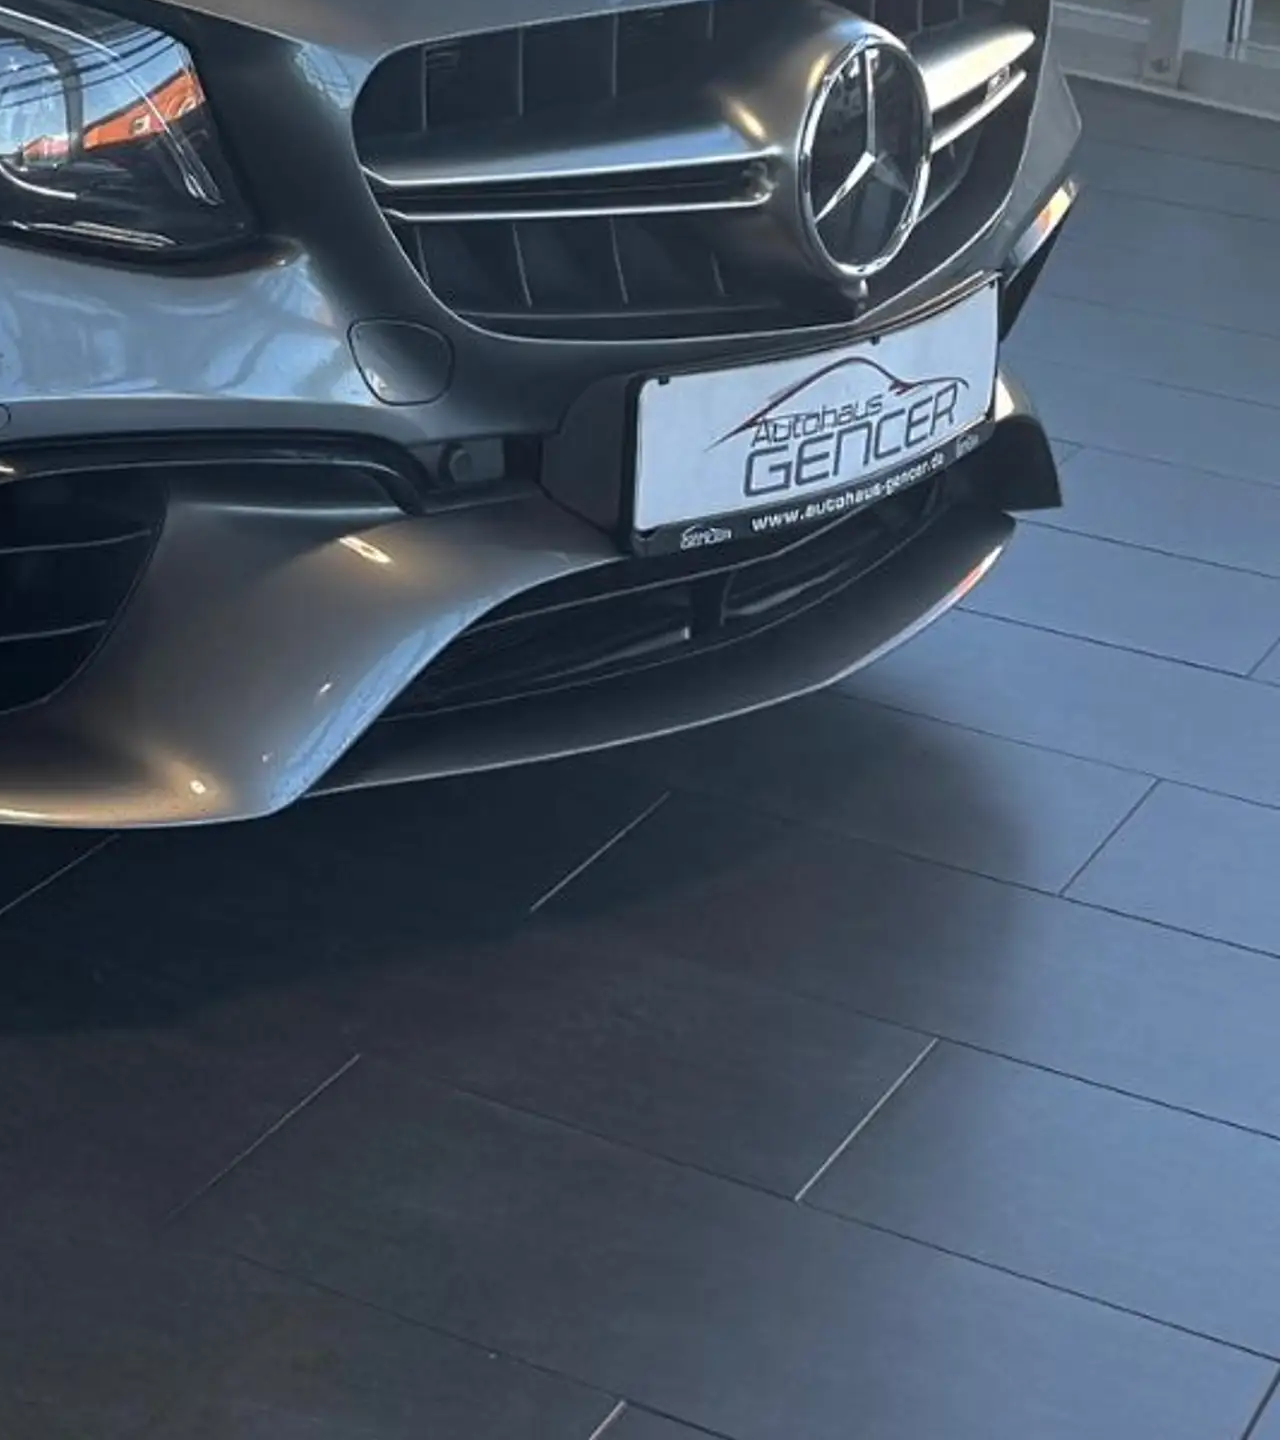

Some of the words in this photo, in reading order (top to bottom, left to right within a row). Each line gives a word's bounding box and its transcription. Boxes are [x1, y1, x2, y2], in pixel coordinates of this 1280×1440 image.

[743, 381, 959, 498] GENCER
[751, 393, 884, 448] Autohaus
[751, 451, 945, 532] www.autohaus-gencer.de
